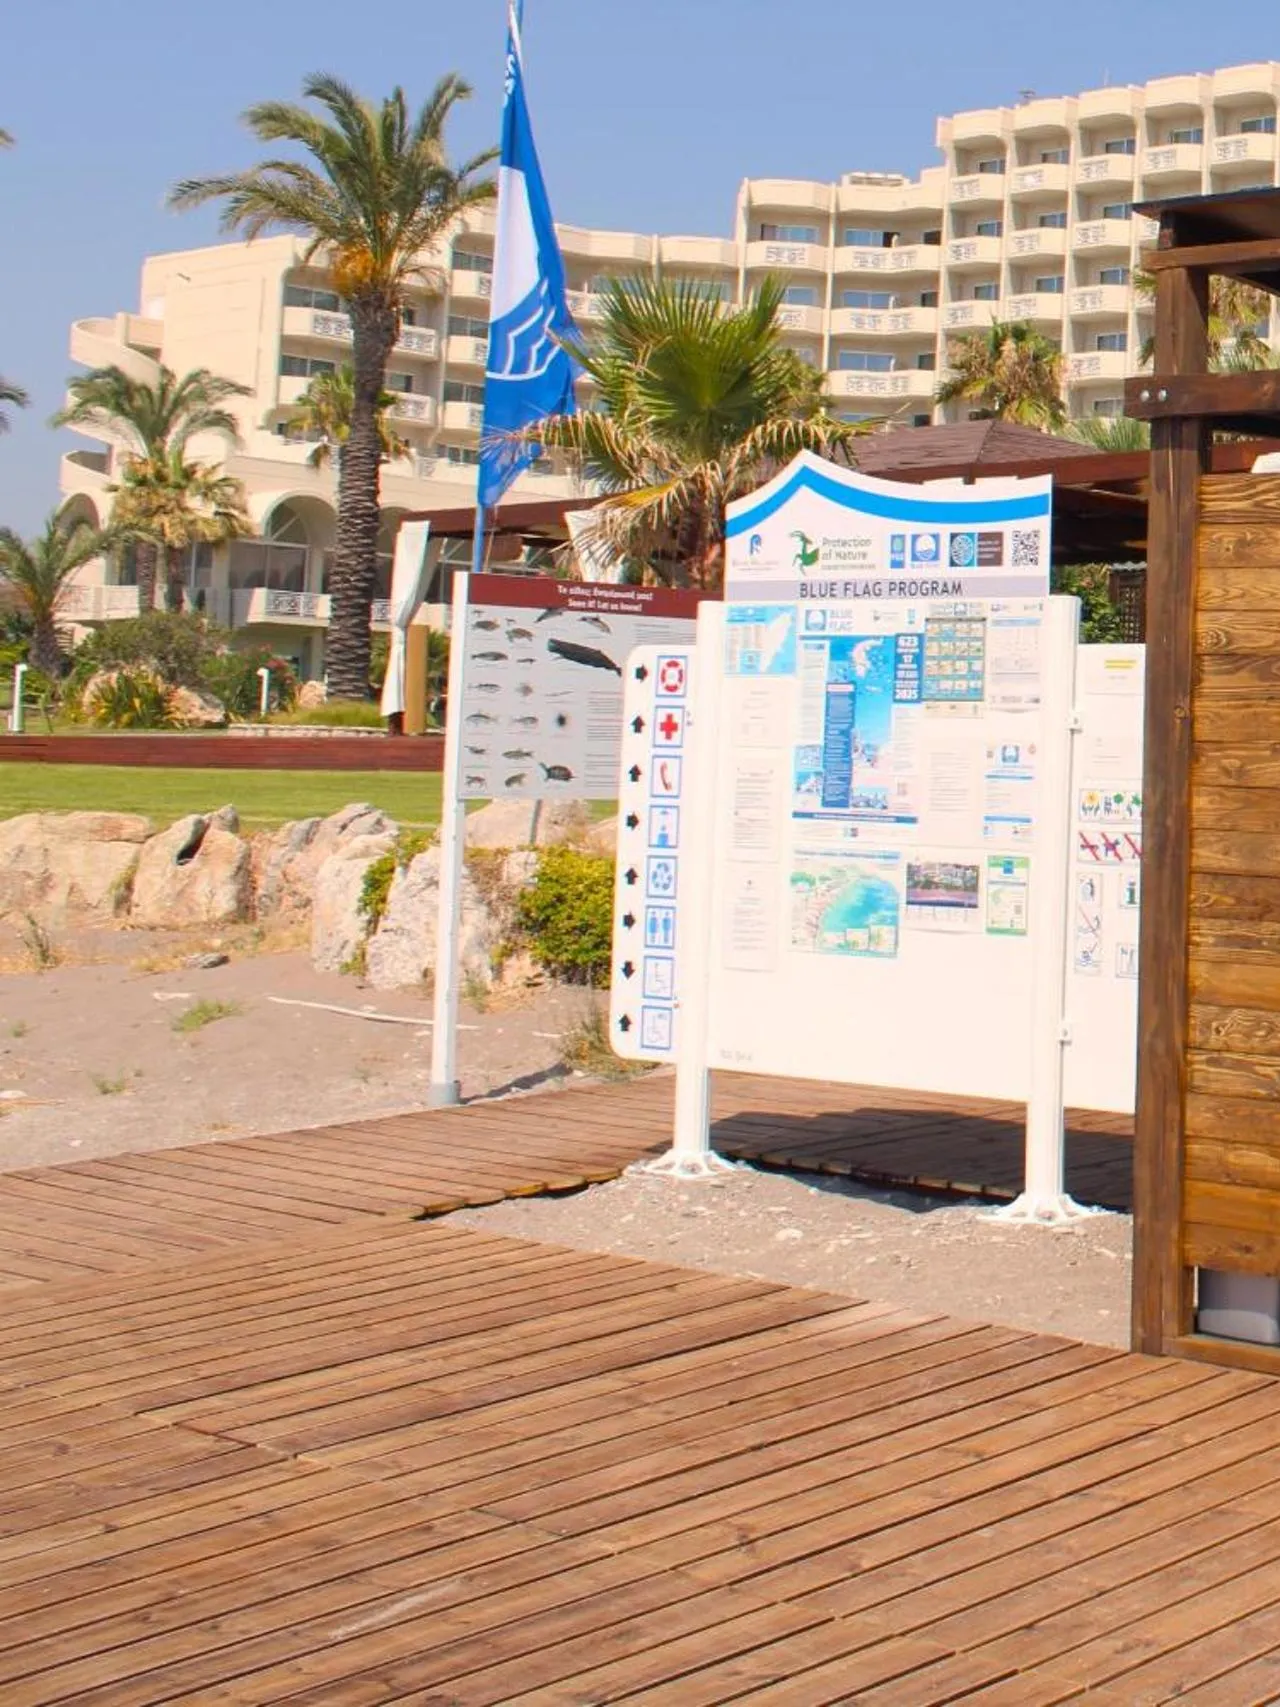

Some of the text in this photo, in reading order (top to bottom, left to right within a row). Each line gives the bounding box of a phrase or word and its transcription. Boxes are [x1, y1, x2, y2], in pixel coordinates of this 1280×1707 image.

[799, 579, 964, 598] BLUE FLAG PROGRAM
